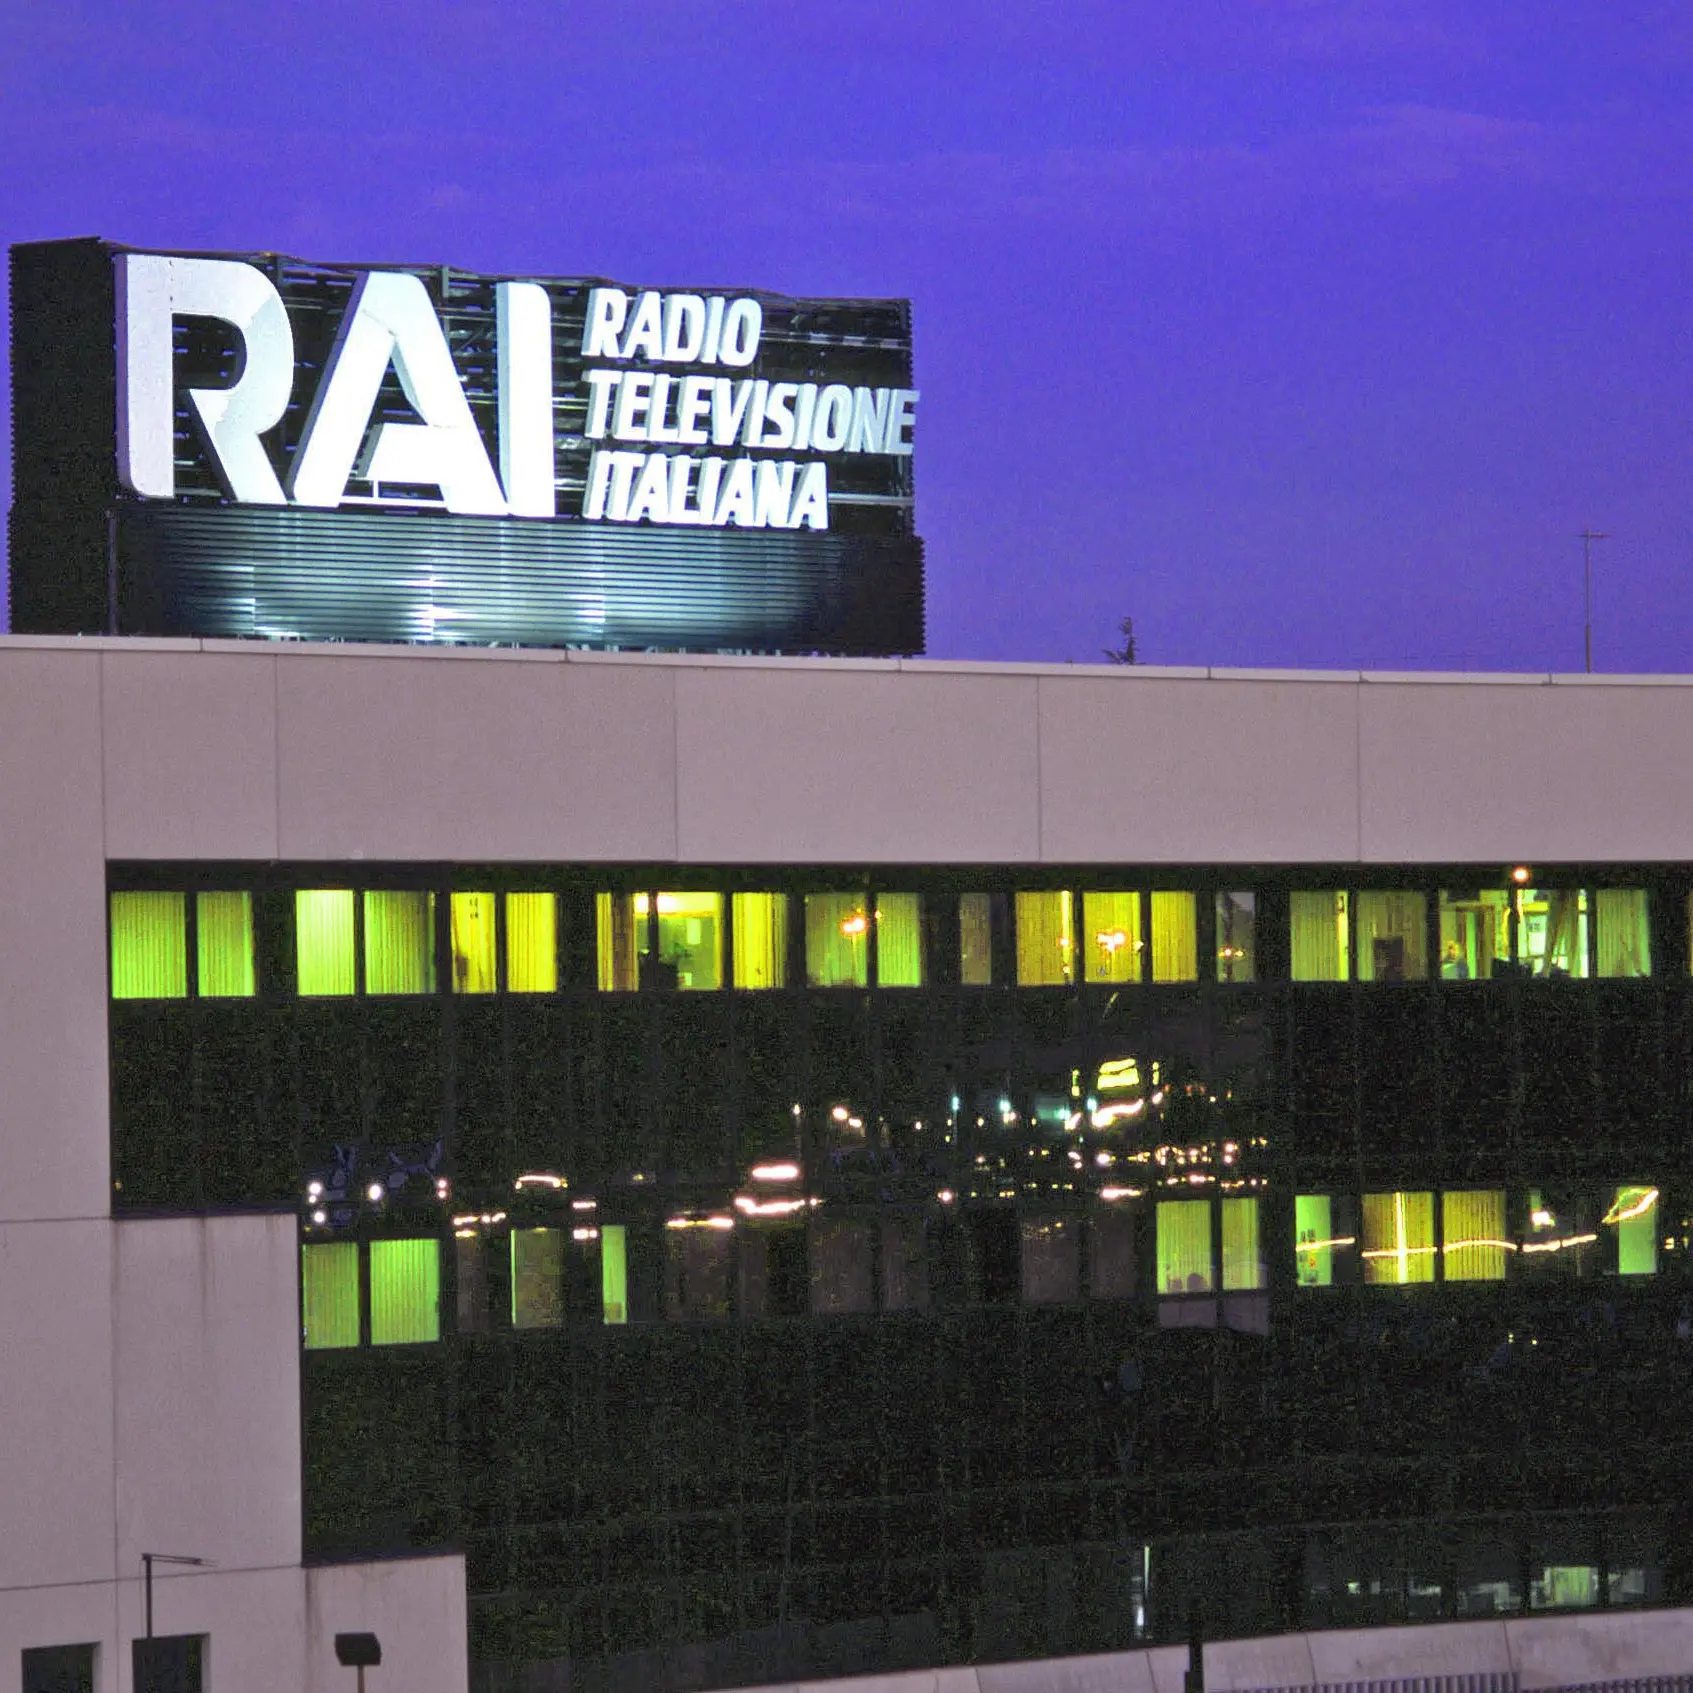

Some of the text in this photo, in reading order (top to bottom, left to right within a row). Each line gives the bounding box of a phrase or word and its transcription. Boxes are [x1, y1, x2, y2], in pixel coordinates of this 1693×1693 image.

[582, 288, 763, 367] RADIO
[115, 254, 556, 518] RAI
[583, 369, 920, 455] TELEVISIONE
[583, 450, 829, 529] ITALIANA
